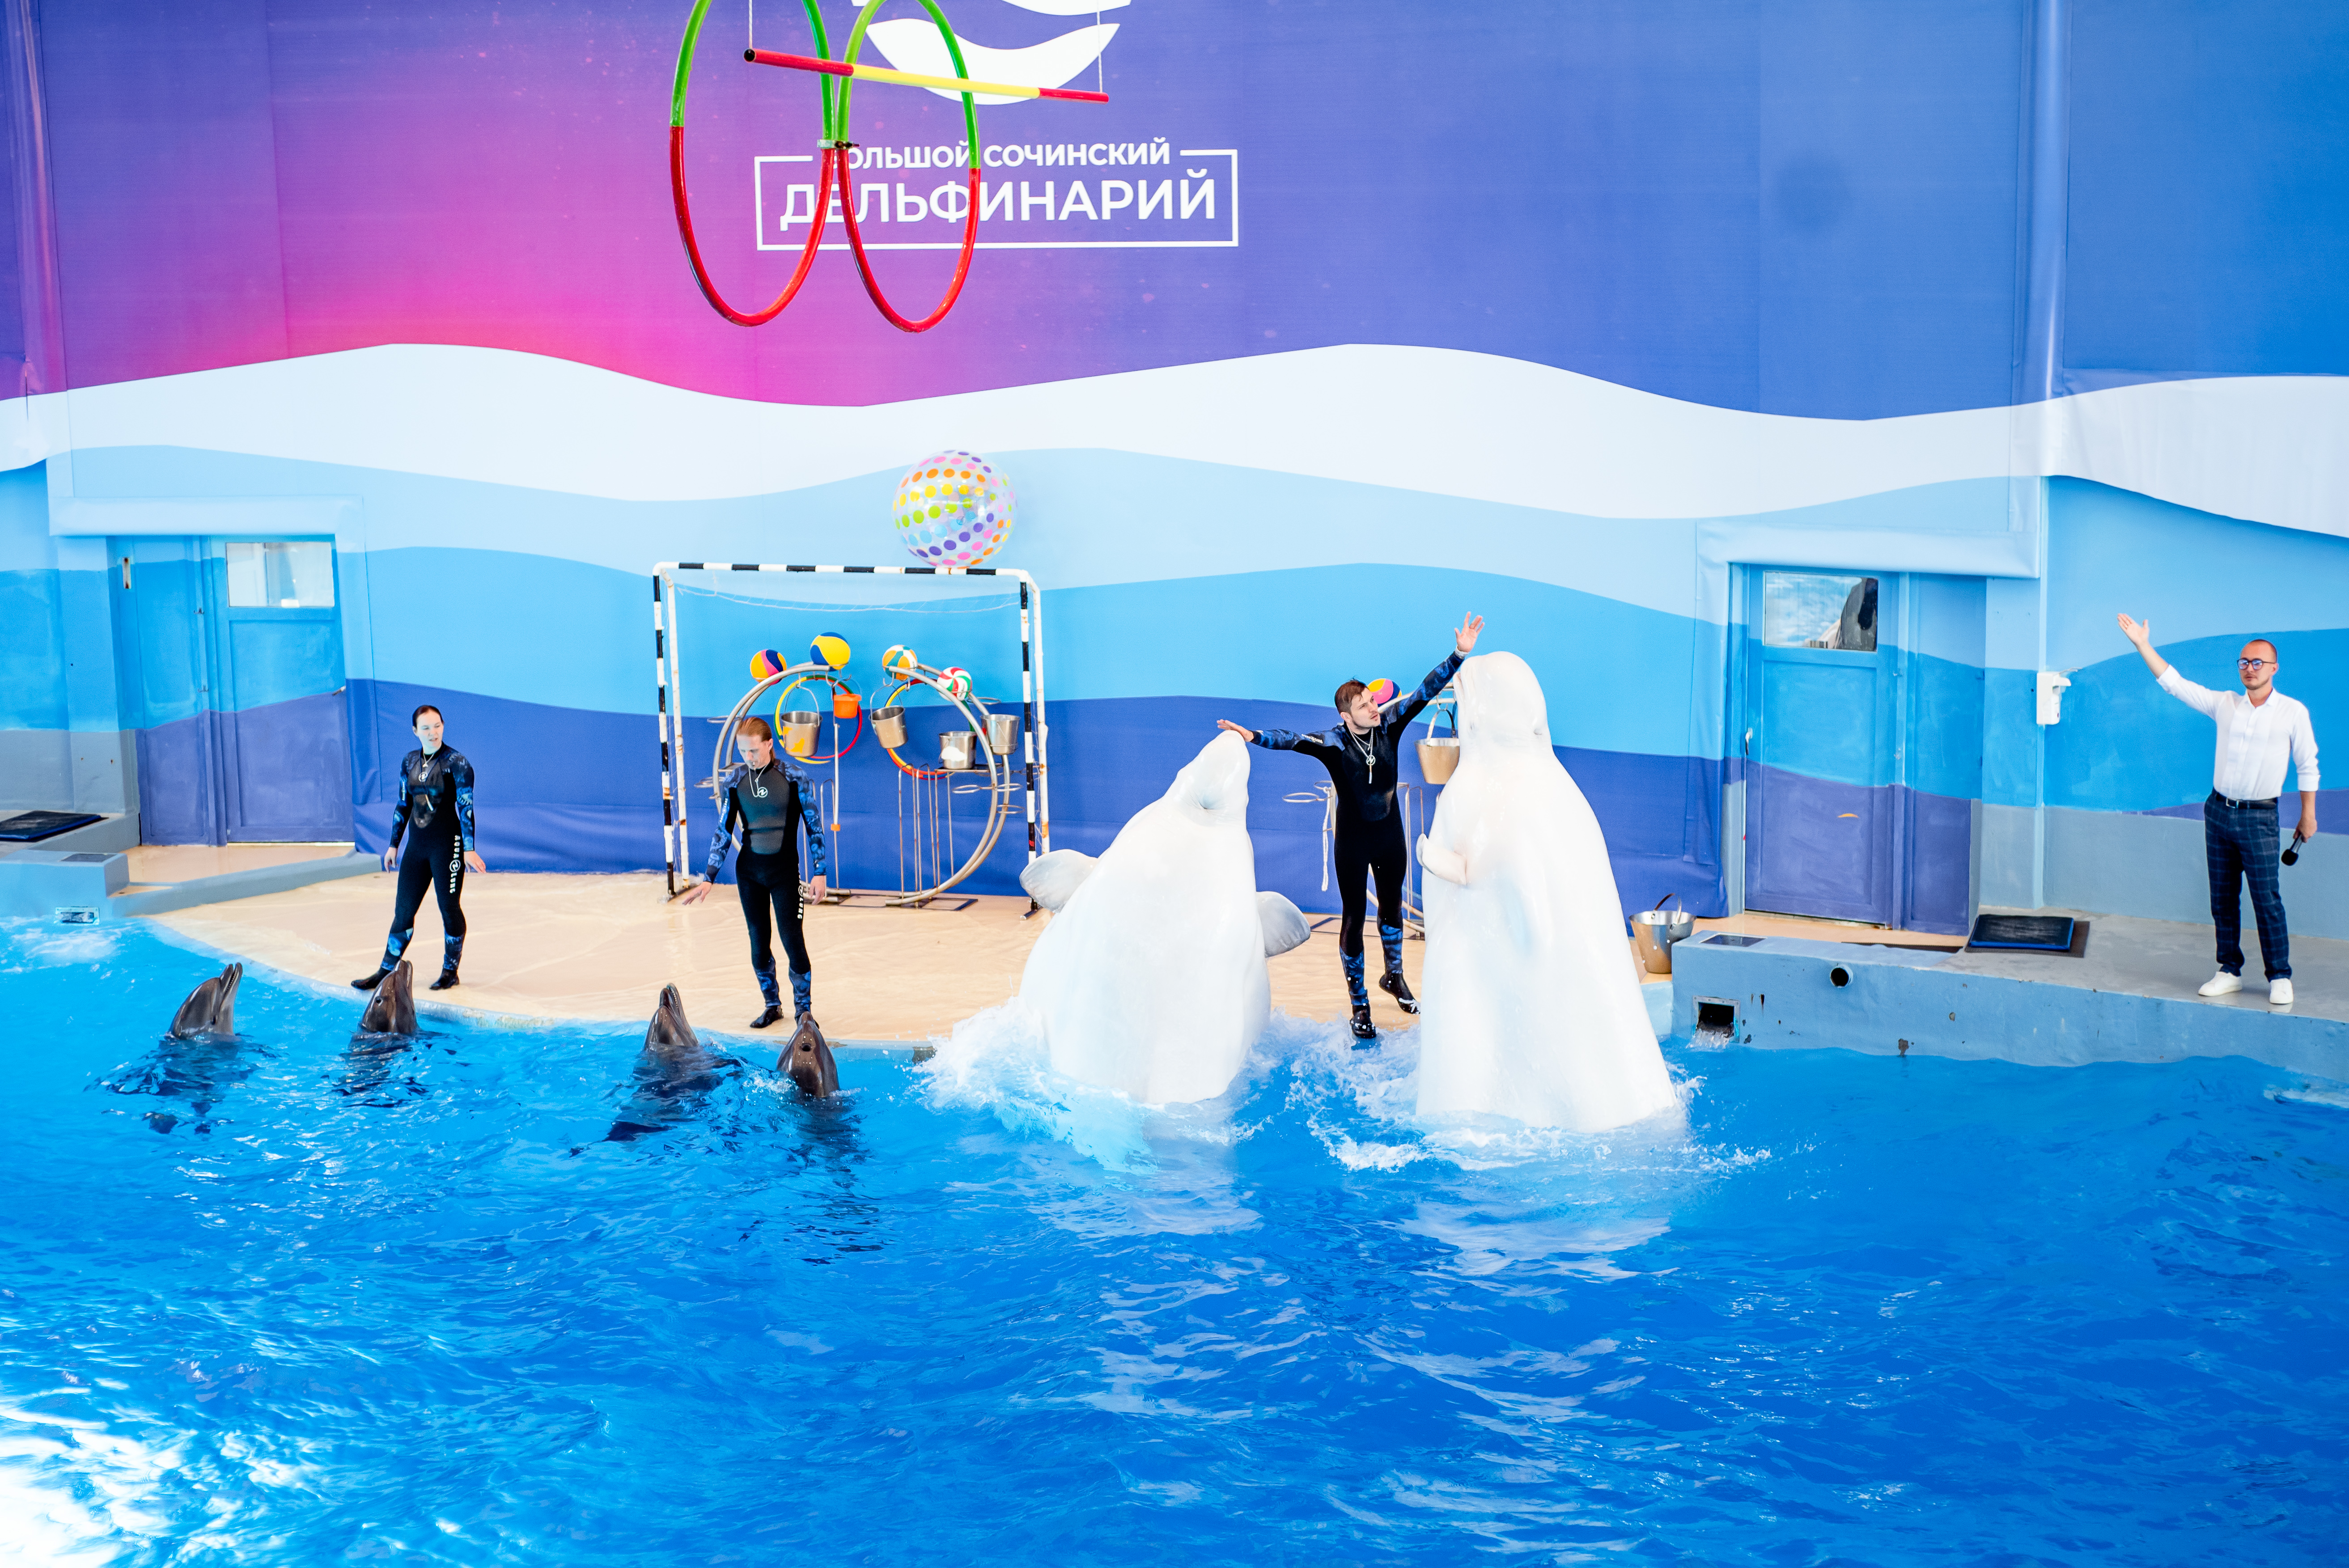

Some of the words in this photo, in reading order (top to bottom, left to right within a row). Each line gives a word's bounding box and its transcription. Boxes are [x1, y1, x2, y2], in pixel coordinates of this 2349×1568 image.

[832, 140, 972, 170] ОЛЬШОЙ
[983, 137, 1170, 167] СОЧИНСКИЙ
[780, 168, 1215, 232] ДЕЛЬФИНАРИЙ
